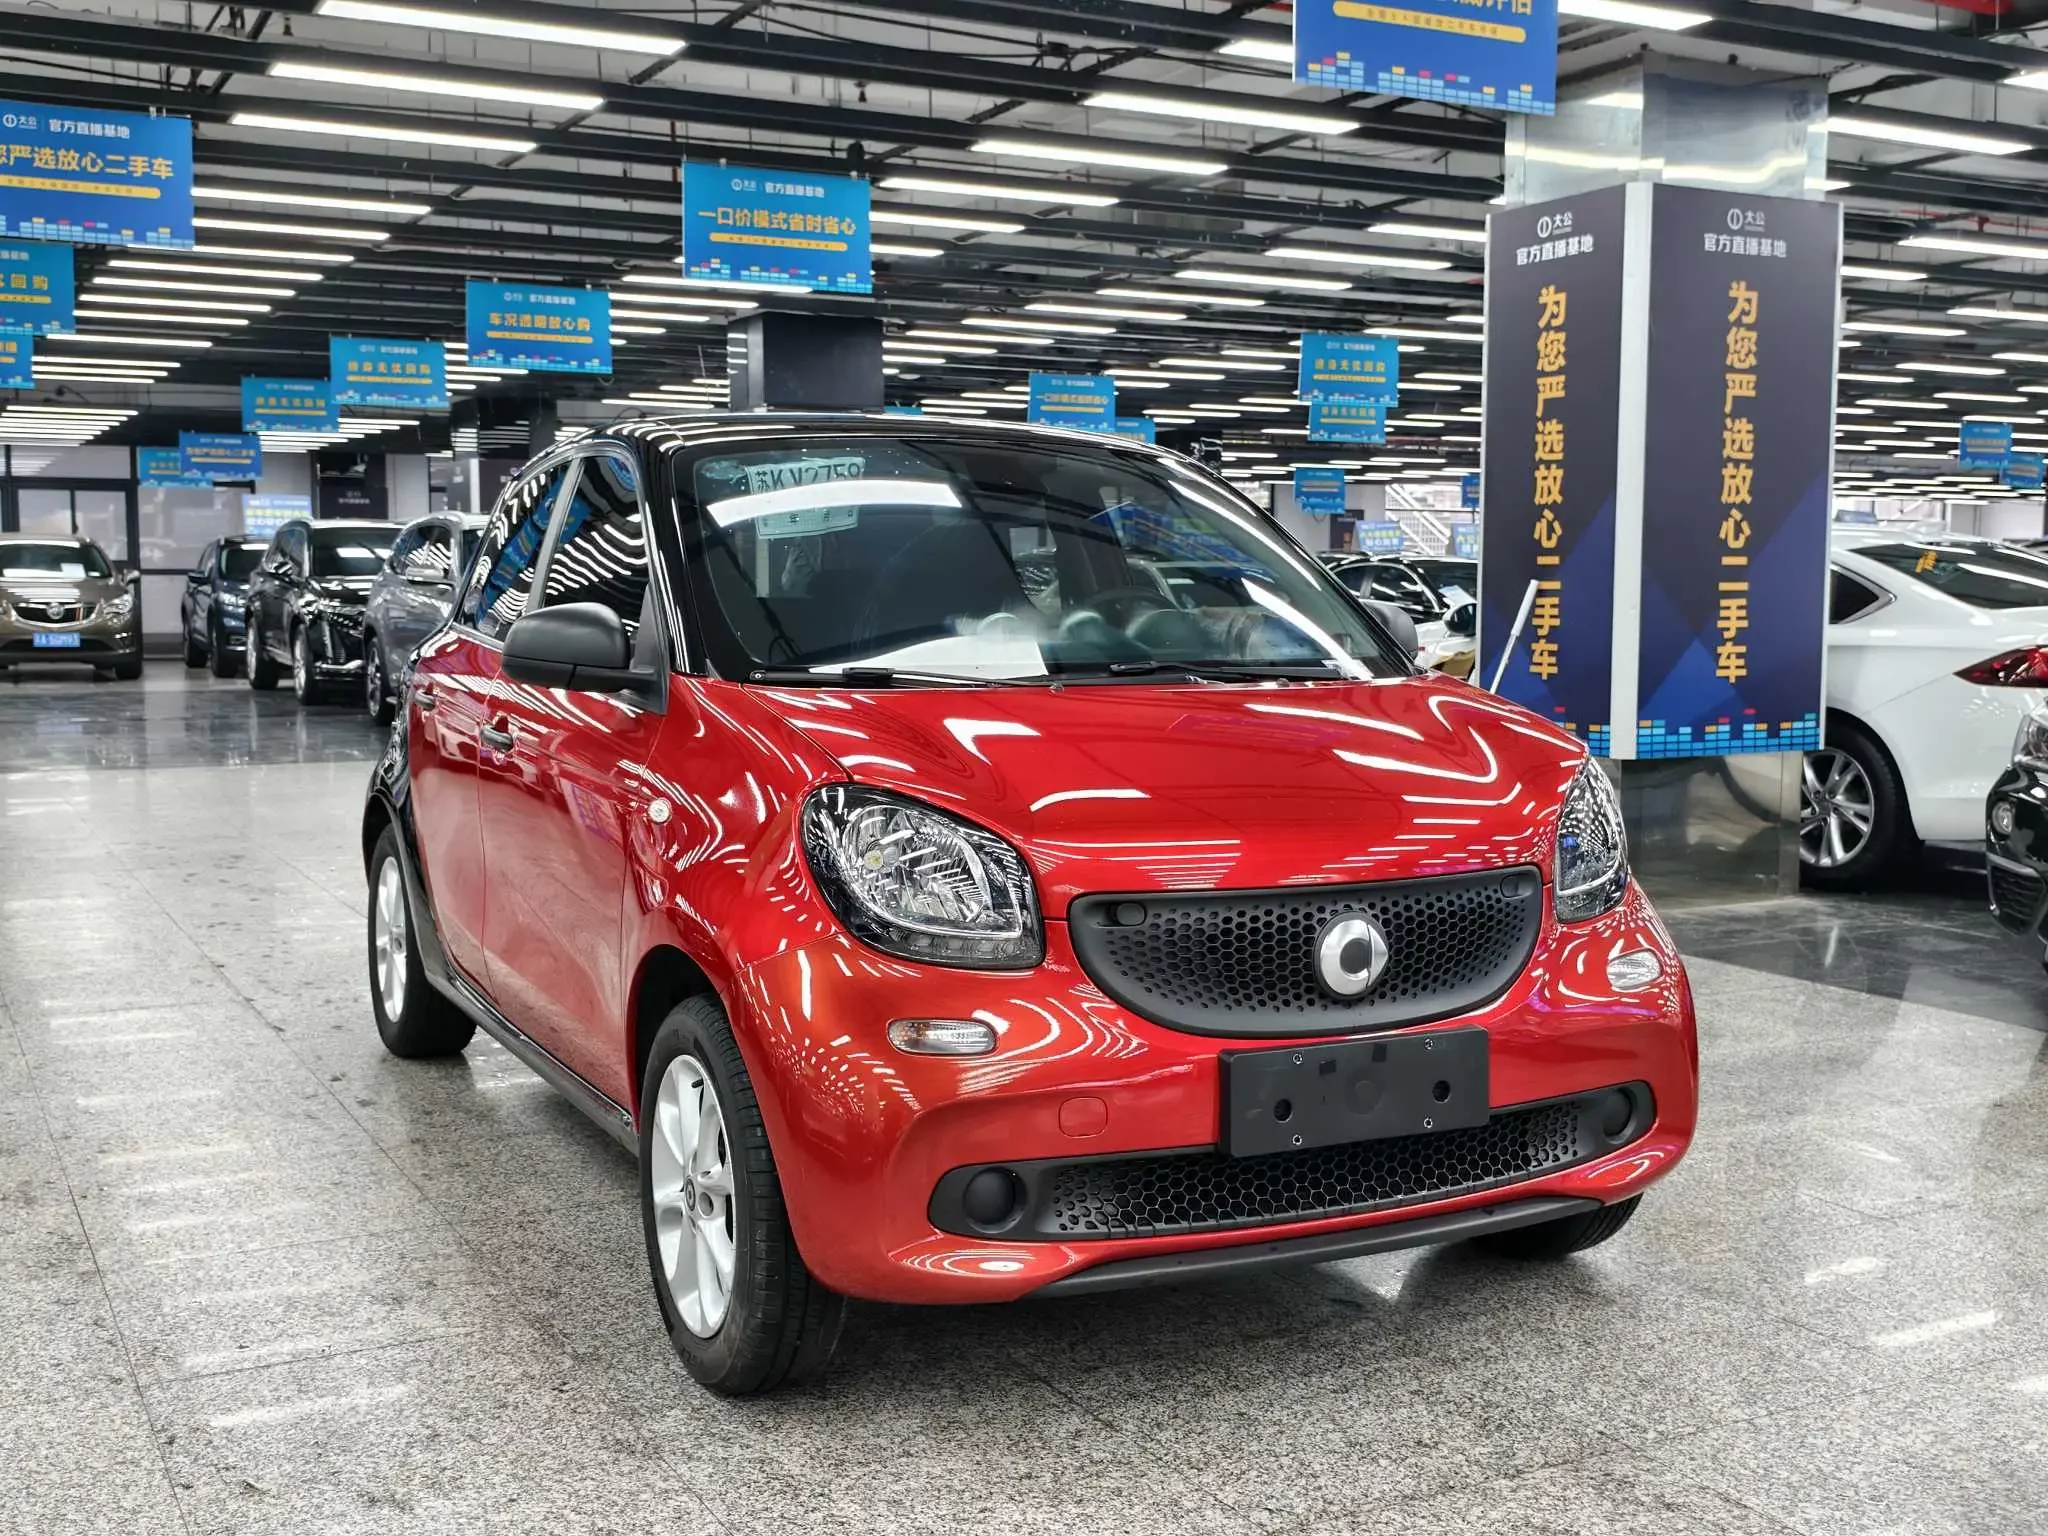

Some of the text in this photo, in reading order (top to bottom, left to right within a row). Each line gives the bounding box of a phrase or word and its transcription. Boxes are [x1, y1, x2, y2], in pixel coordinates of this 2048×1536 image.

[48, 118, 131, 139] 官方直播基地
[698, 206, 857, 236] 一口价模式省时省心
[1553, 211, 1573, 229] 大公
[1744, 210, 1766, 225] 大公
[1516, 233, 1594, 266] 官方直播基地
[1703, 232, 1787, 258] 官方直播基地
[1529, 284, 1568, 681] 为您严选放心二手车
[1715, 280, 1759, 684] 为您严选放心二手车
